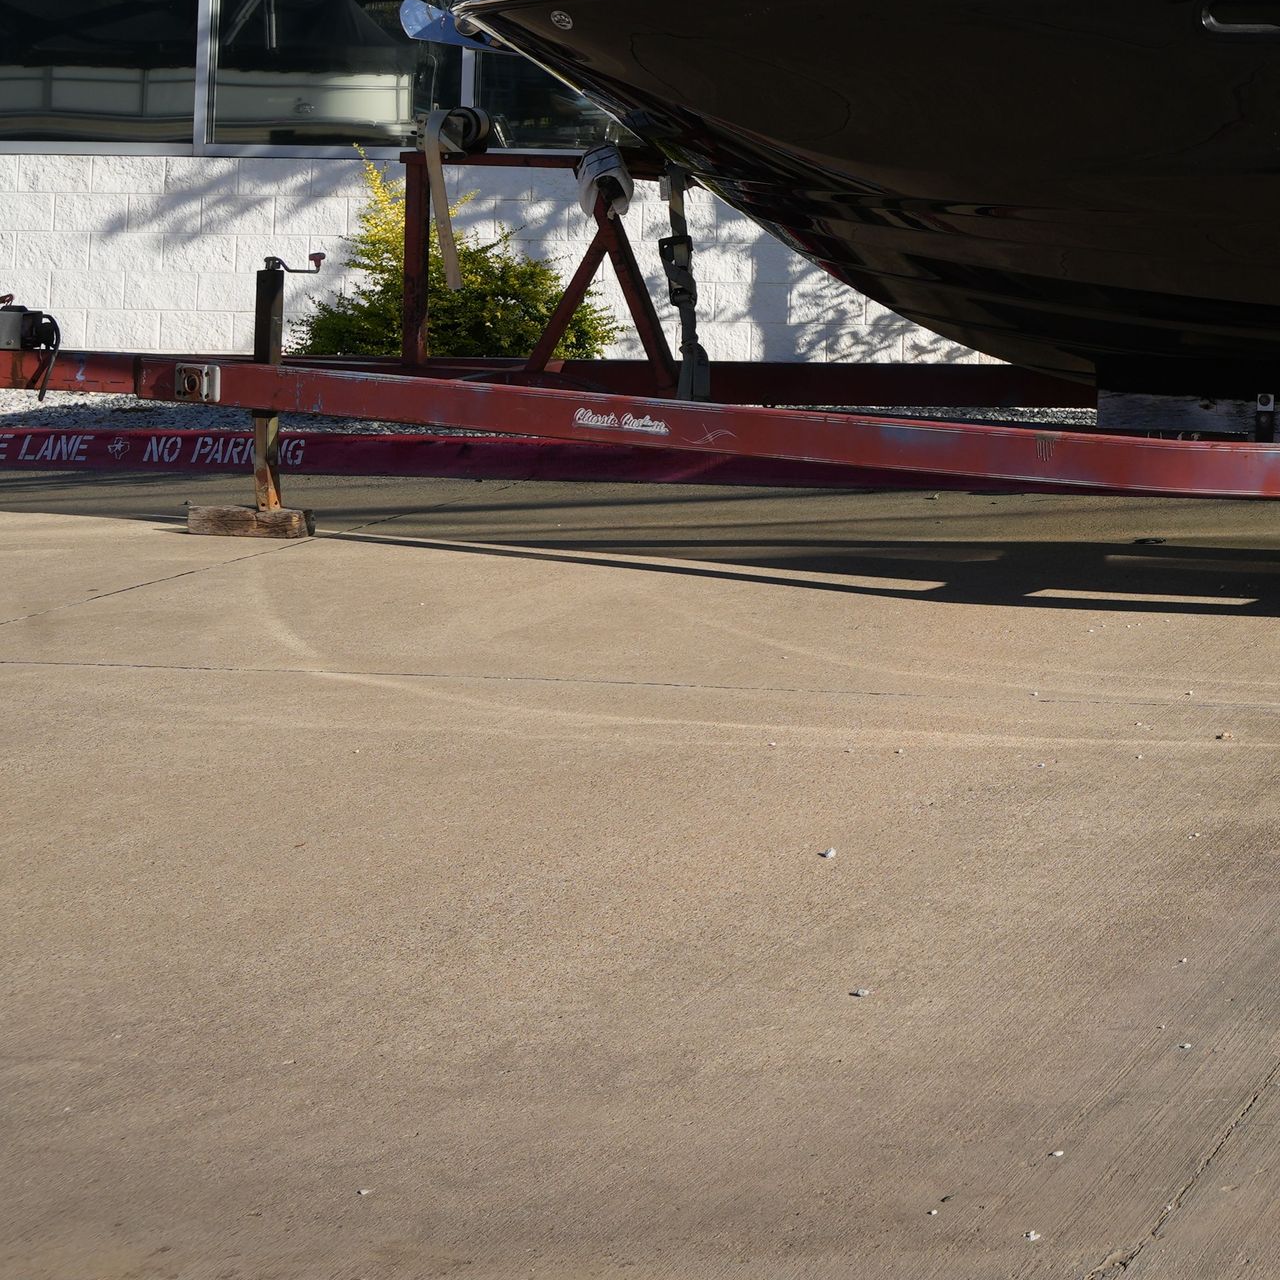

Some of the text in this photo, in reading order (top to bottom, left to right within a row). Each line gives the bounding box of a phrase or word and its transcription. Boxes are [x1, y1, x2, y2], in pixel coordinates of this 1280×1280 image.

[18, 434, 95, 461] LANE
[142, 436, 182, 463] NO
[190, 436, 305, 465] PARKNG
